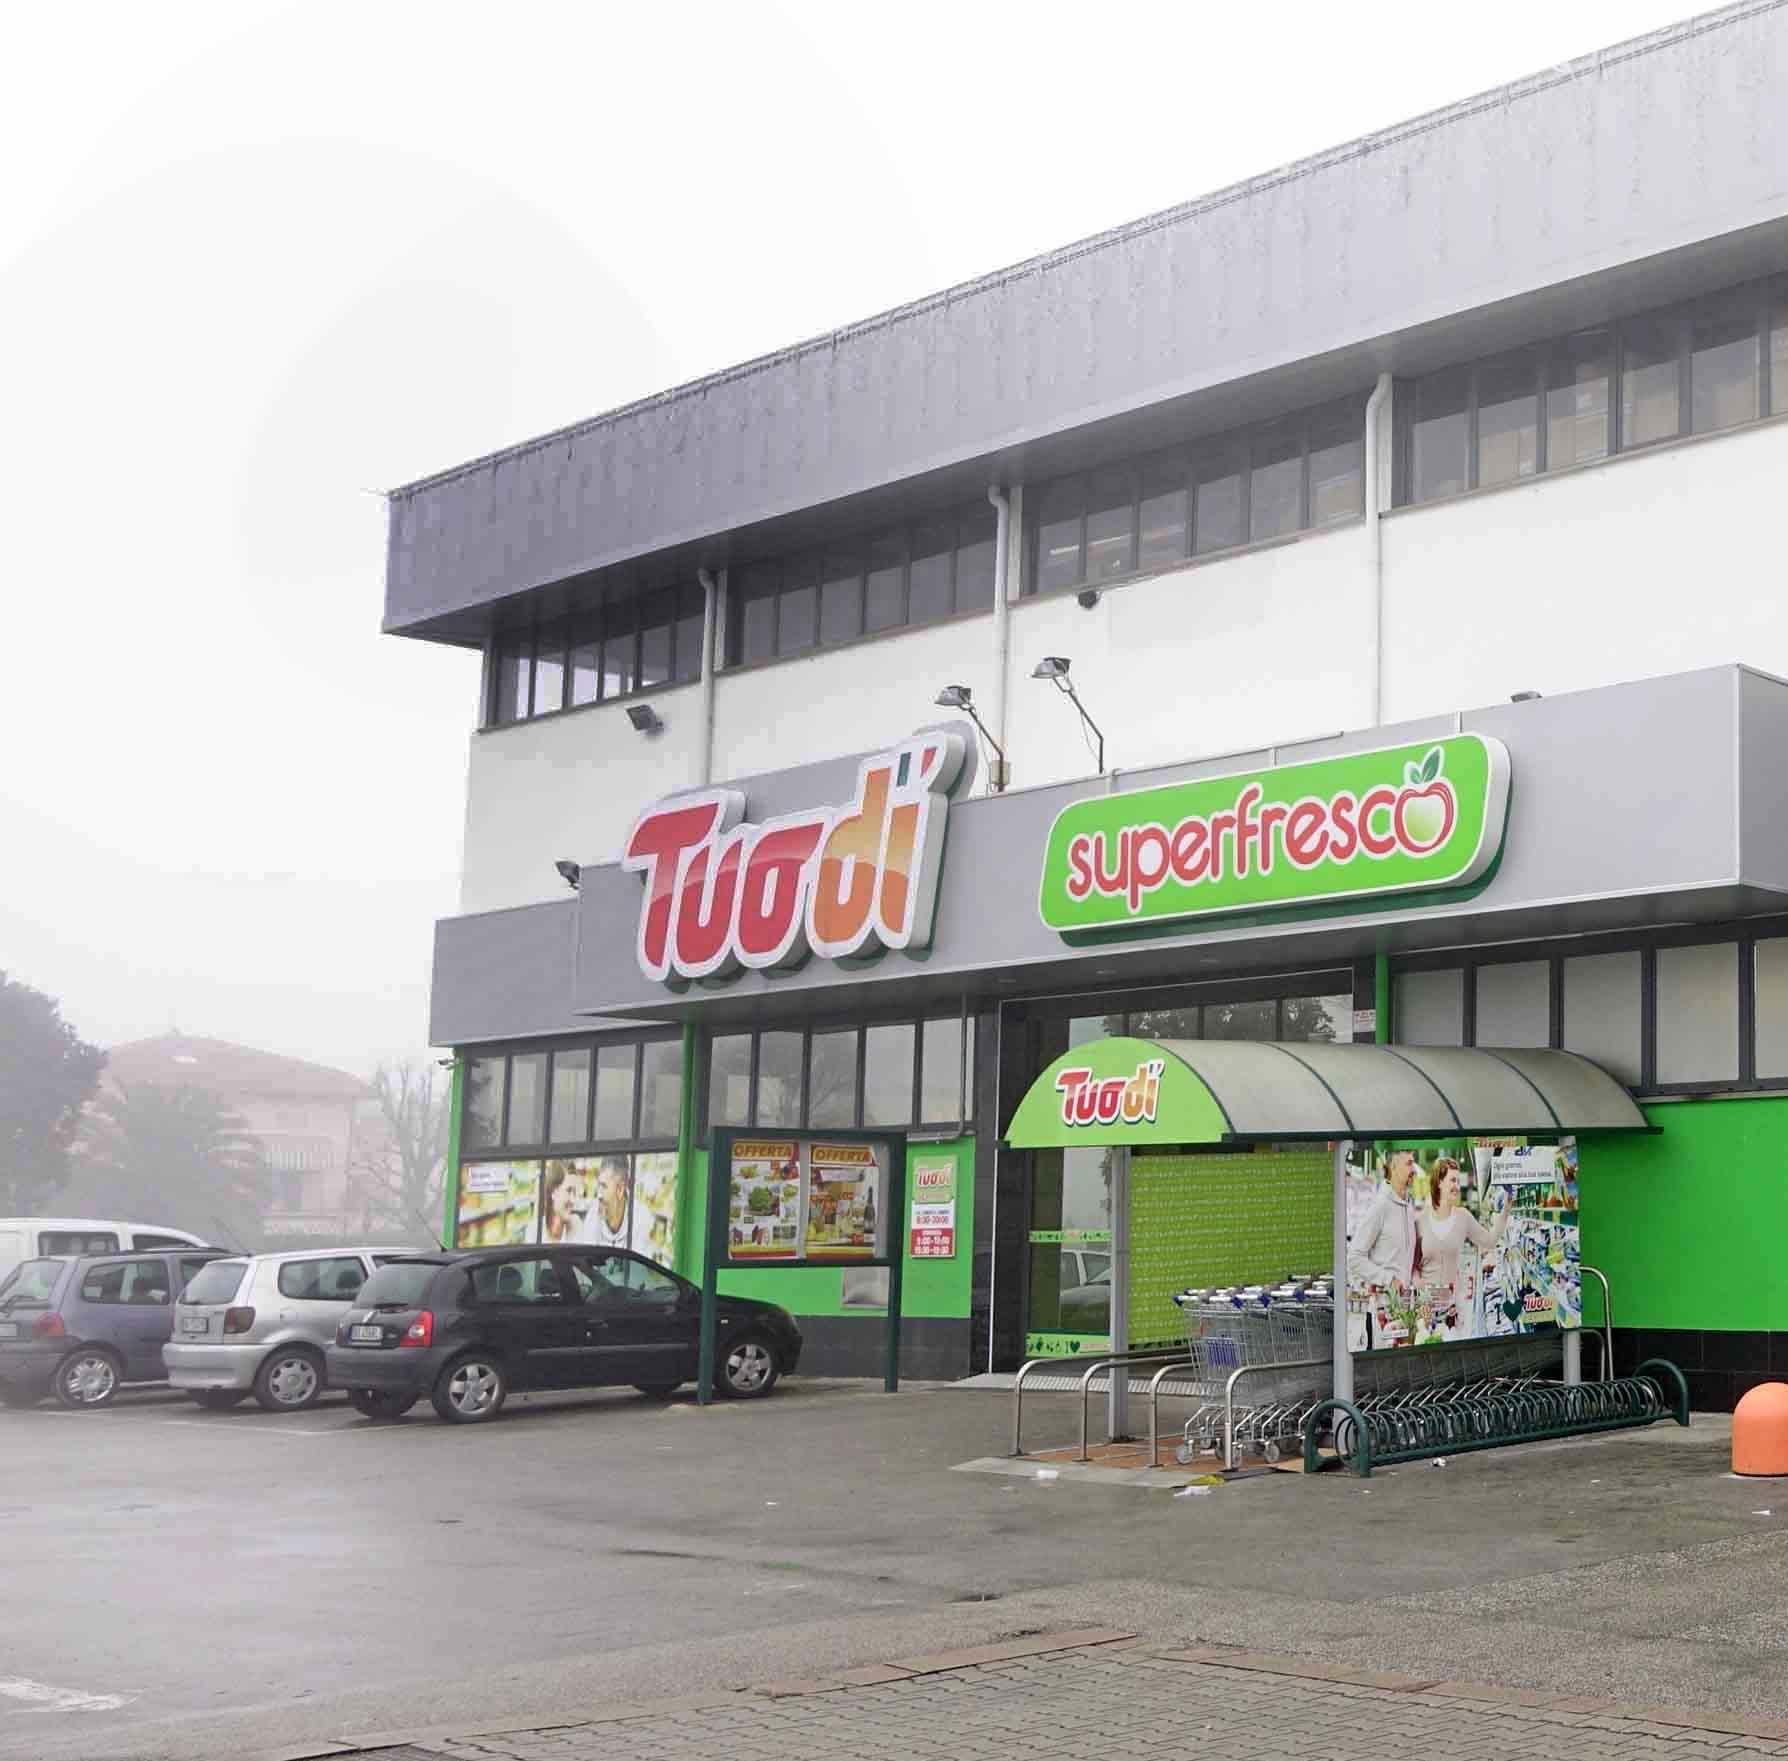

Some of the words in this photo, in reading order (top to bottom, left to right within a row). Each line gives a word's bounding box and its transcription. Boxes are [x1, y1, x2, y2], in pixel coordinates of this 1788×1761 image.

[1067, 780, 1456, 912] superfresco
[734, 1142, 793, 1157] OFFERTA
[815, 1149, 871, 1162] OFFERTA
